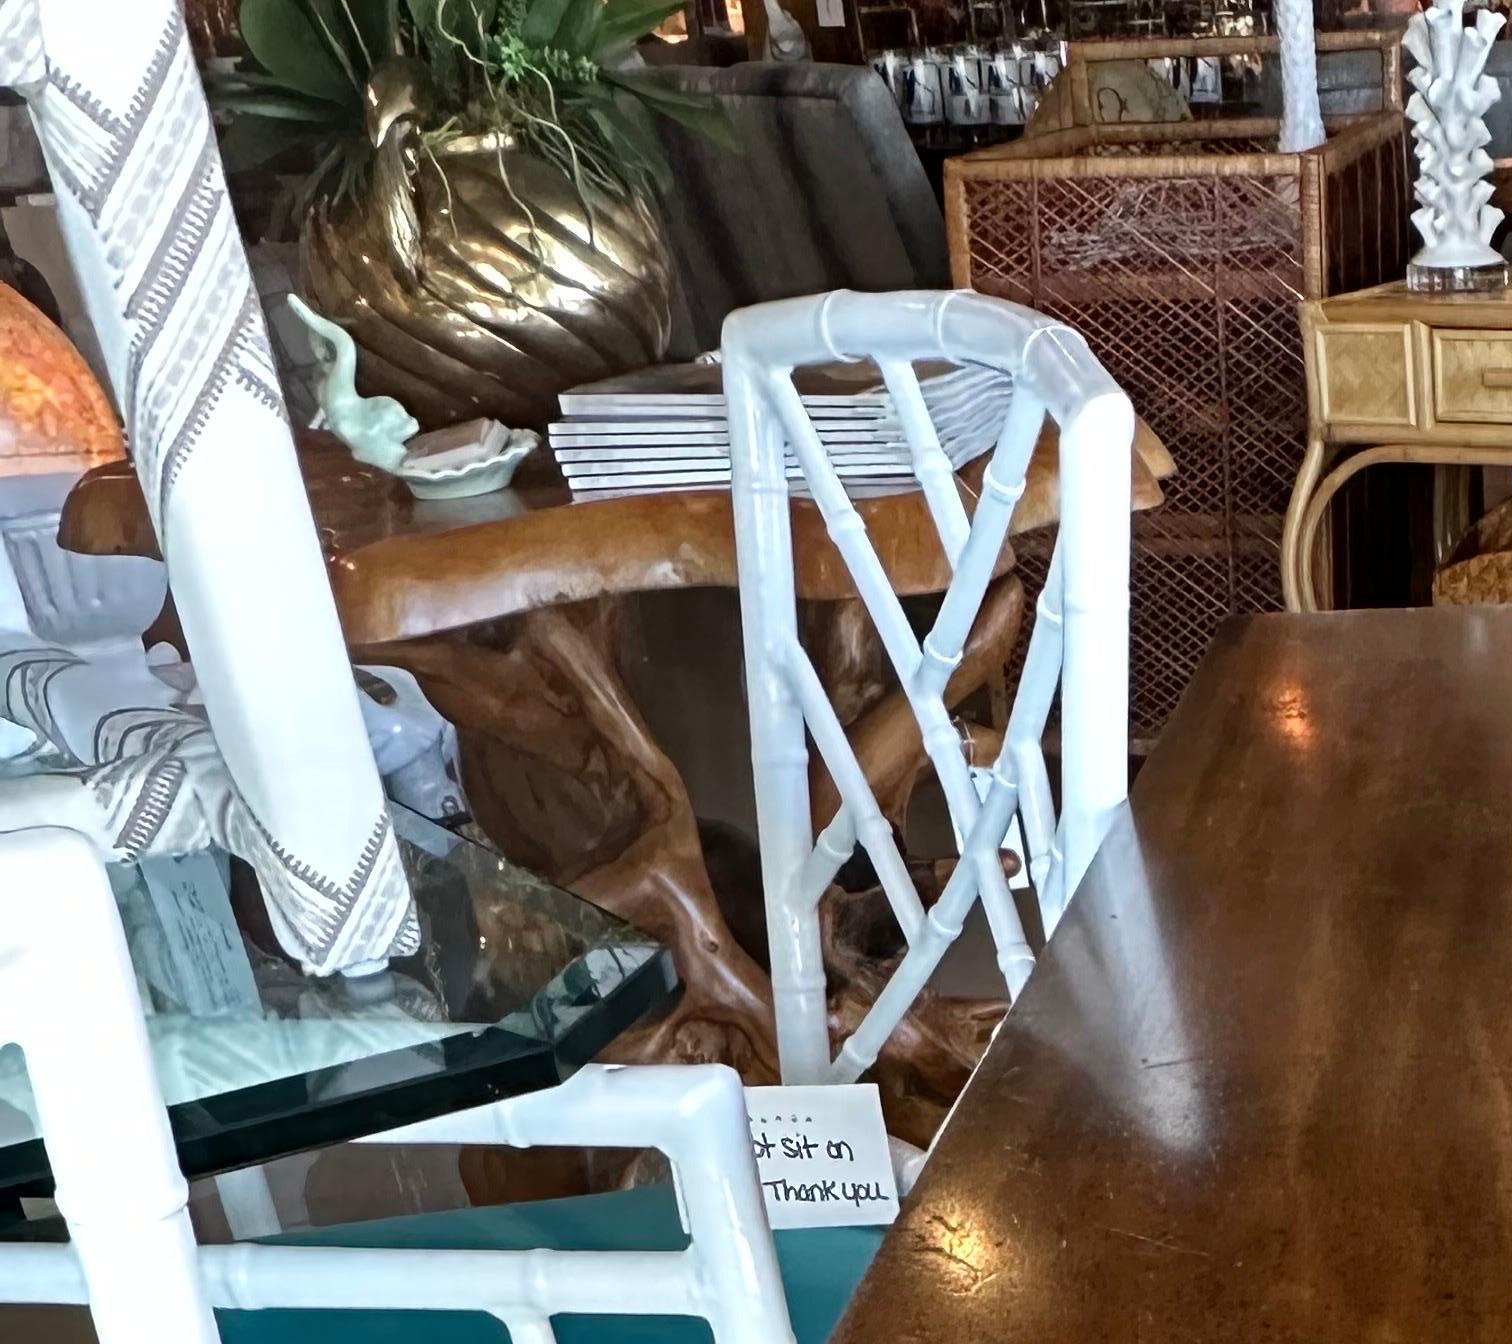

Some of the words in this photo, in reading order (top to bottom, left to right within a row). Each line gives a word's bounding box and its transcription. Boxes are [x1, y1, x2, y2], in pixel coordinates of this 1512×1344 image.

[753, 1132, 776, 1159] ot
[827, 1139, 854, 1161] on
[762, 1179, 840, 1202] Thank
[842, 1181, 889, 1207] you
